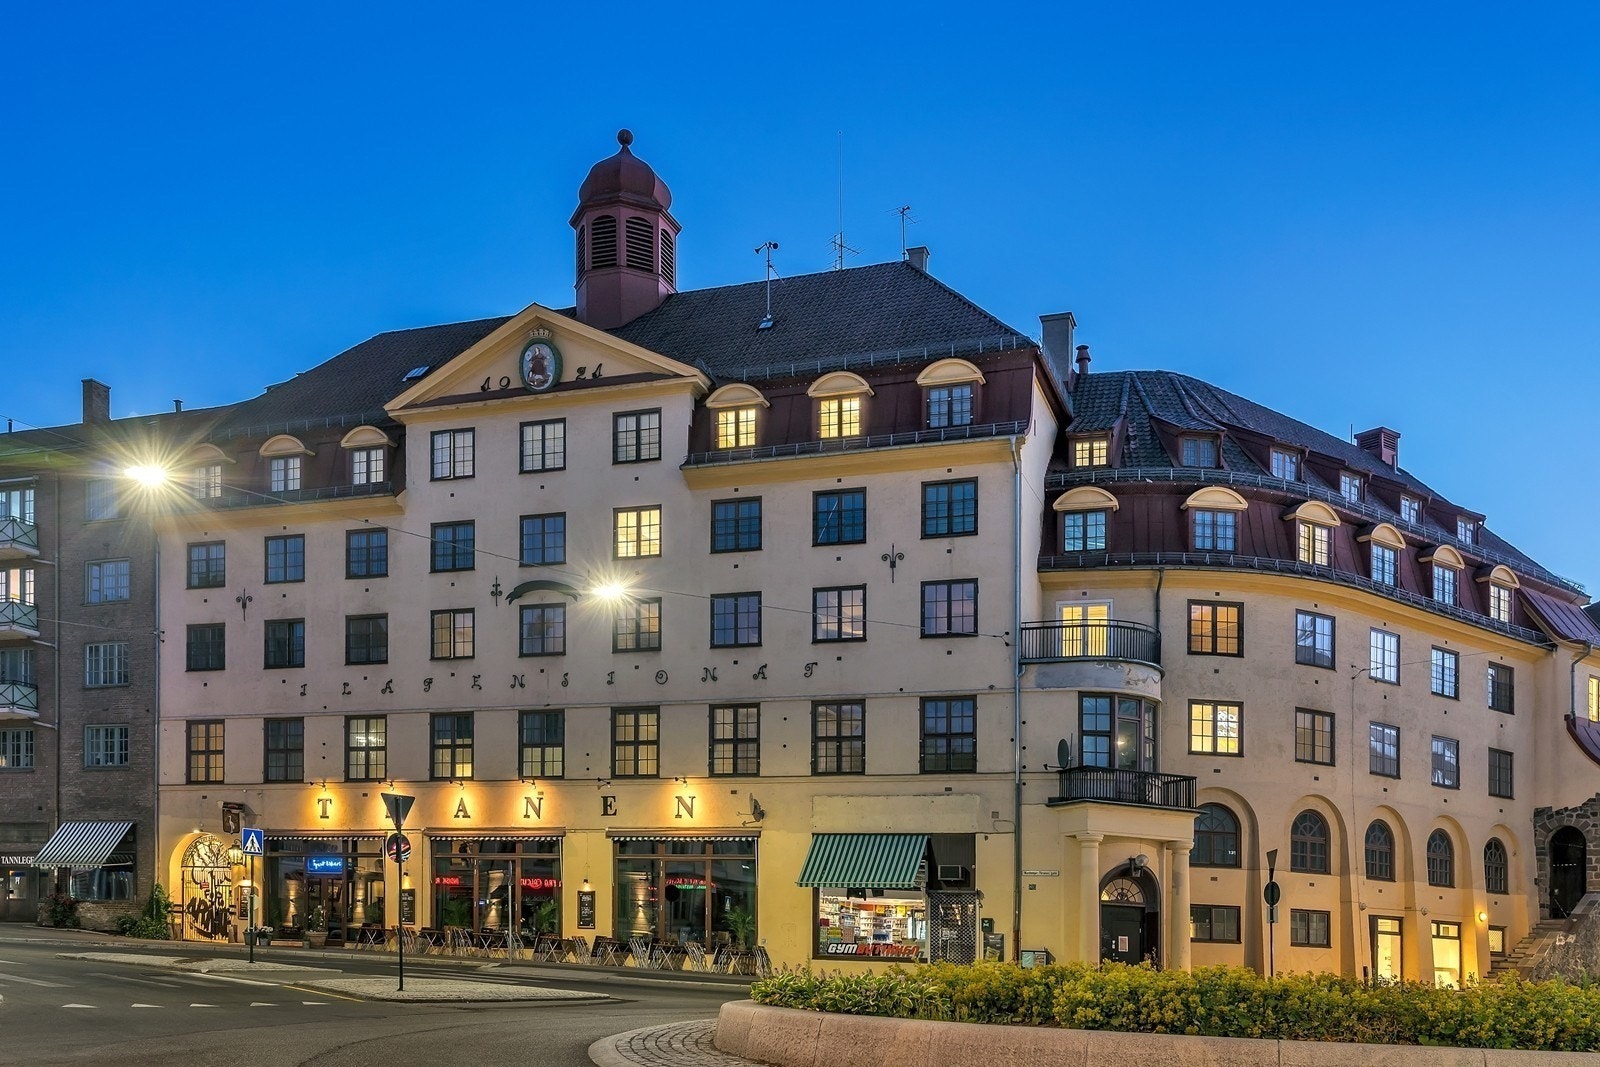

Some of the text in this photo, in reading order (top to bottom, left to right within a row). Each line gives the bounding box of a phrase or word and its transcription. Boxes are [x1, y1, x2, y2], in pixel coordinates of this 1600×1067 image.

[299, 662, 818, 697] ILA PENSIONAT
[317, 795, 697, 819] TANEN
